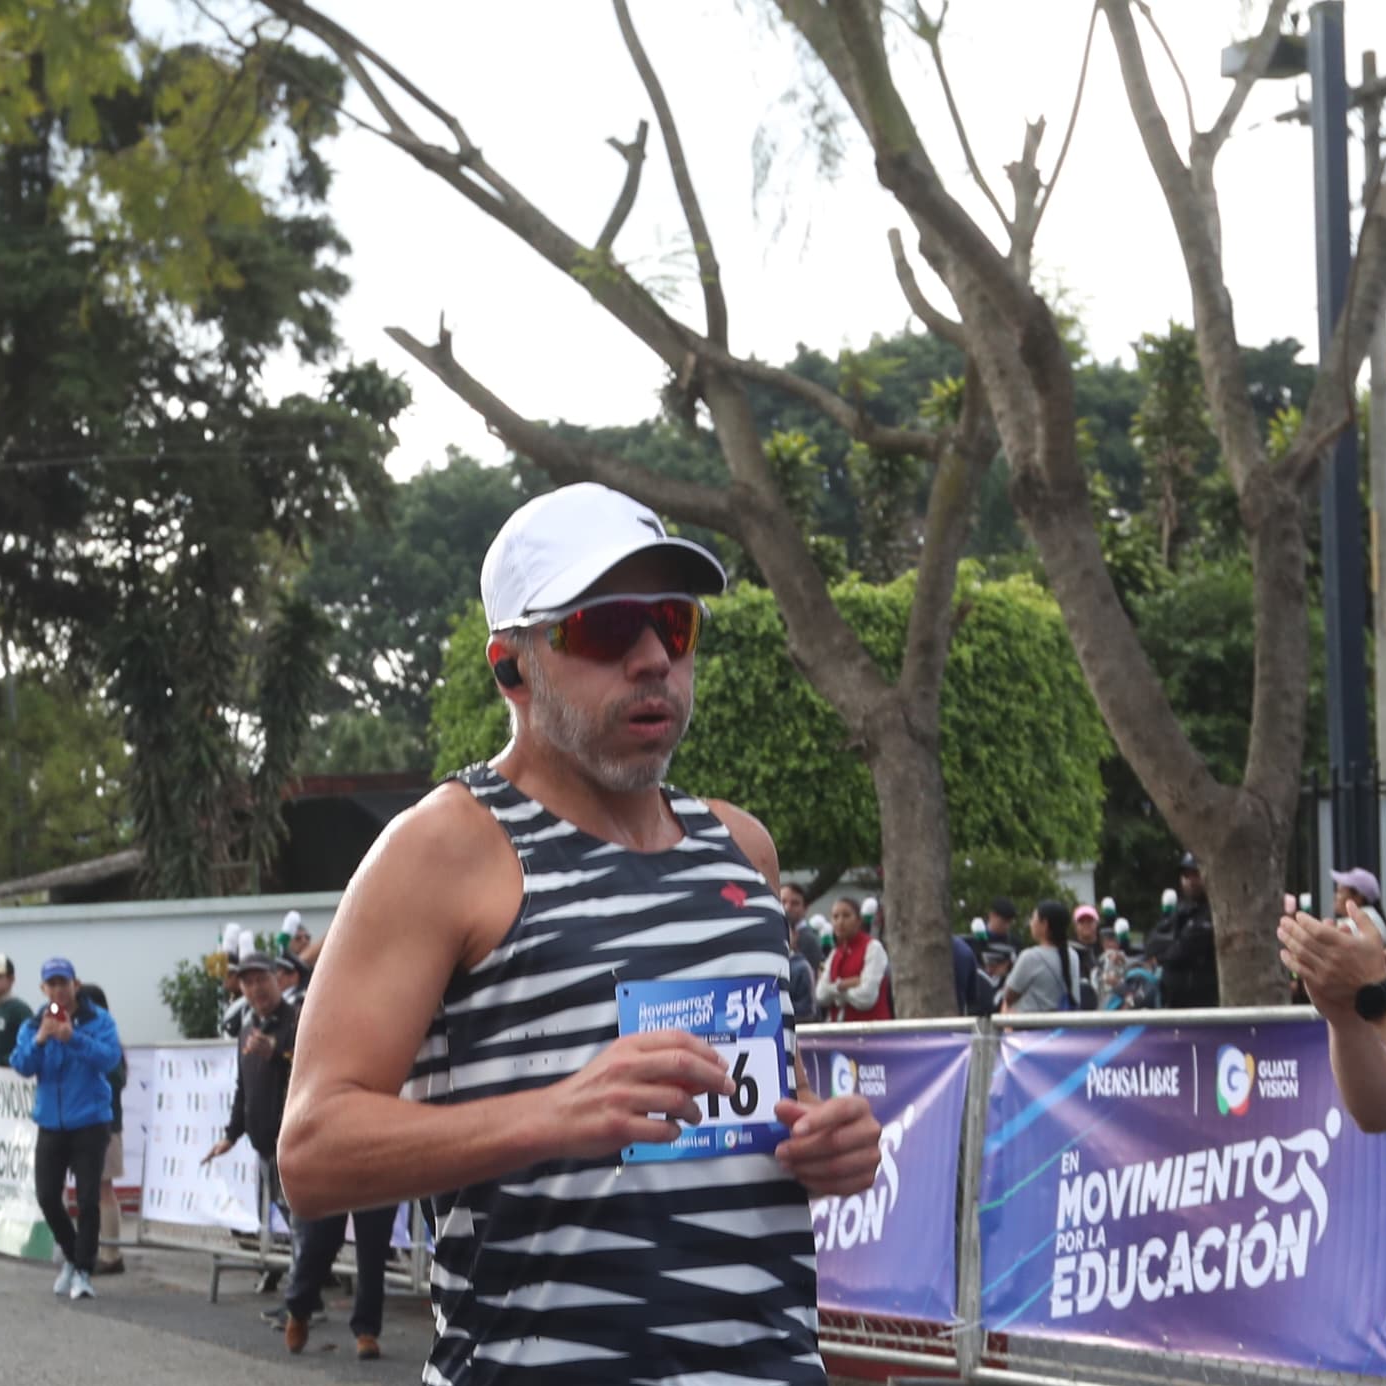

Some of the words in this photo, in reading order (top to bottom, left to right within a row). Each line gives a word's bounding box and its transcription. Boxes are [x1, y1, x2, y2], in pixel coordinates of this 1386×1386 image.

[725, 983, 768, 1030] 5K
[859, 1065, 885, 1081] GUATE
[1258, 1059, 1298, 1078] GUATE
[859, 1081, 887, 1097] VISION
[1258, 1079, 1299, 1099] VISION
[1061, 1149, 1080, 1175] EN
[1056, 1135, 1284, 1230] MOVIMIENTO
[1056, 1228, 1084, 1255] POR
[1088, 1224, 1106, 1249] LA
[1050, 1206, 1312, 1319] EDUCACIÓN
